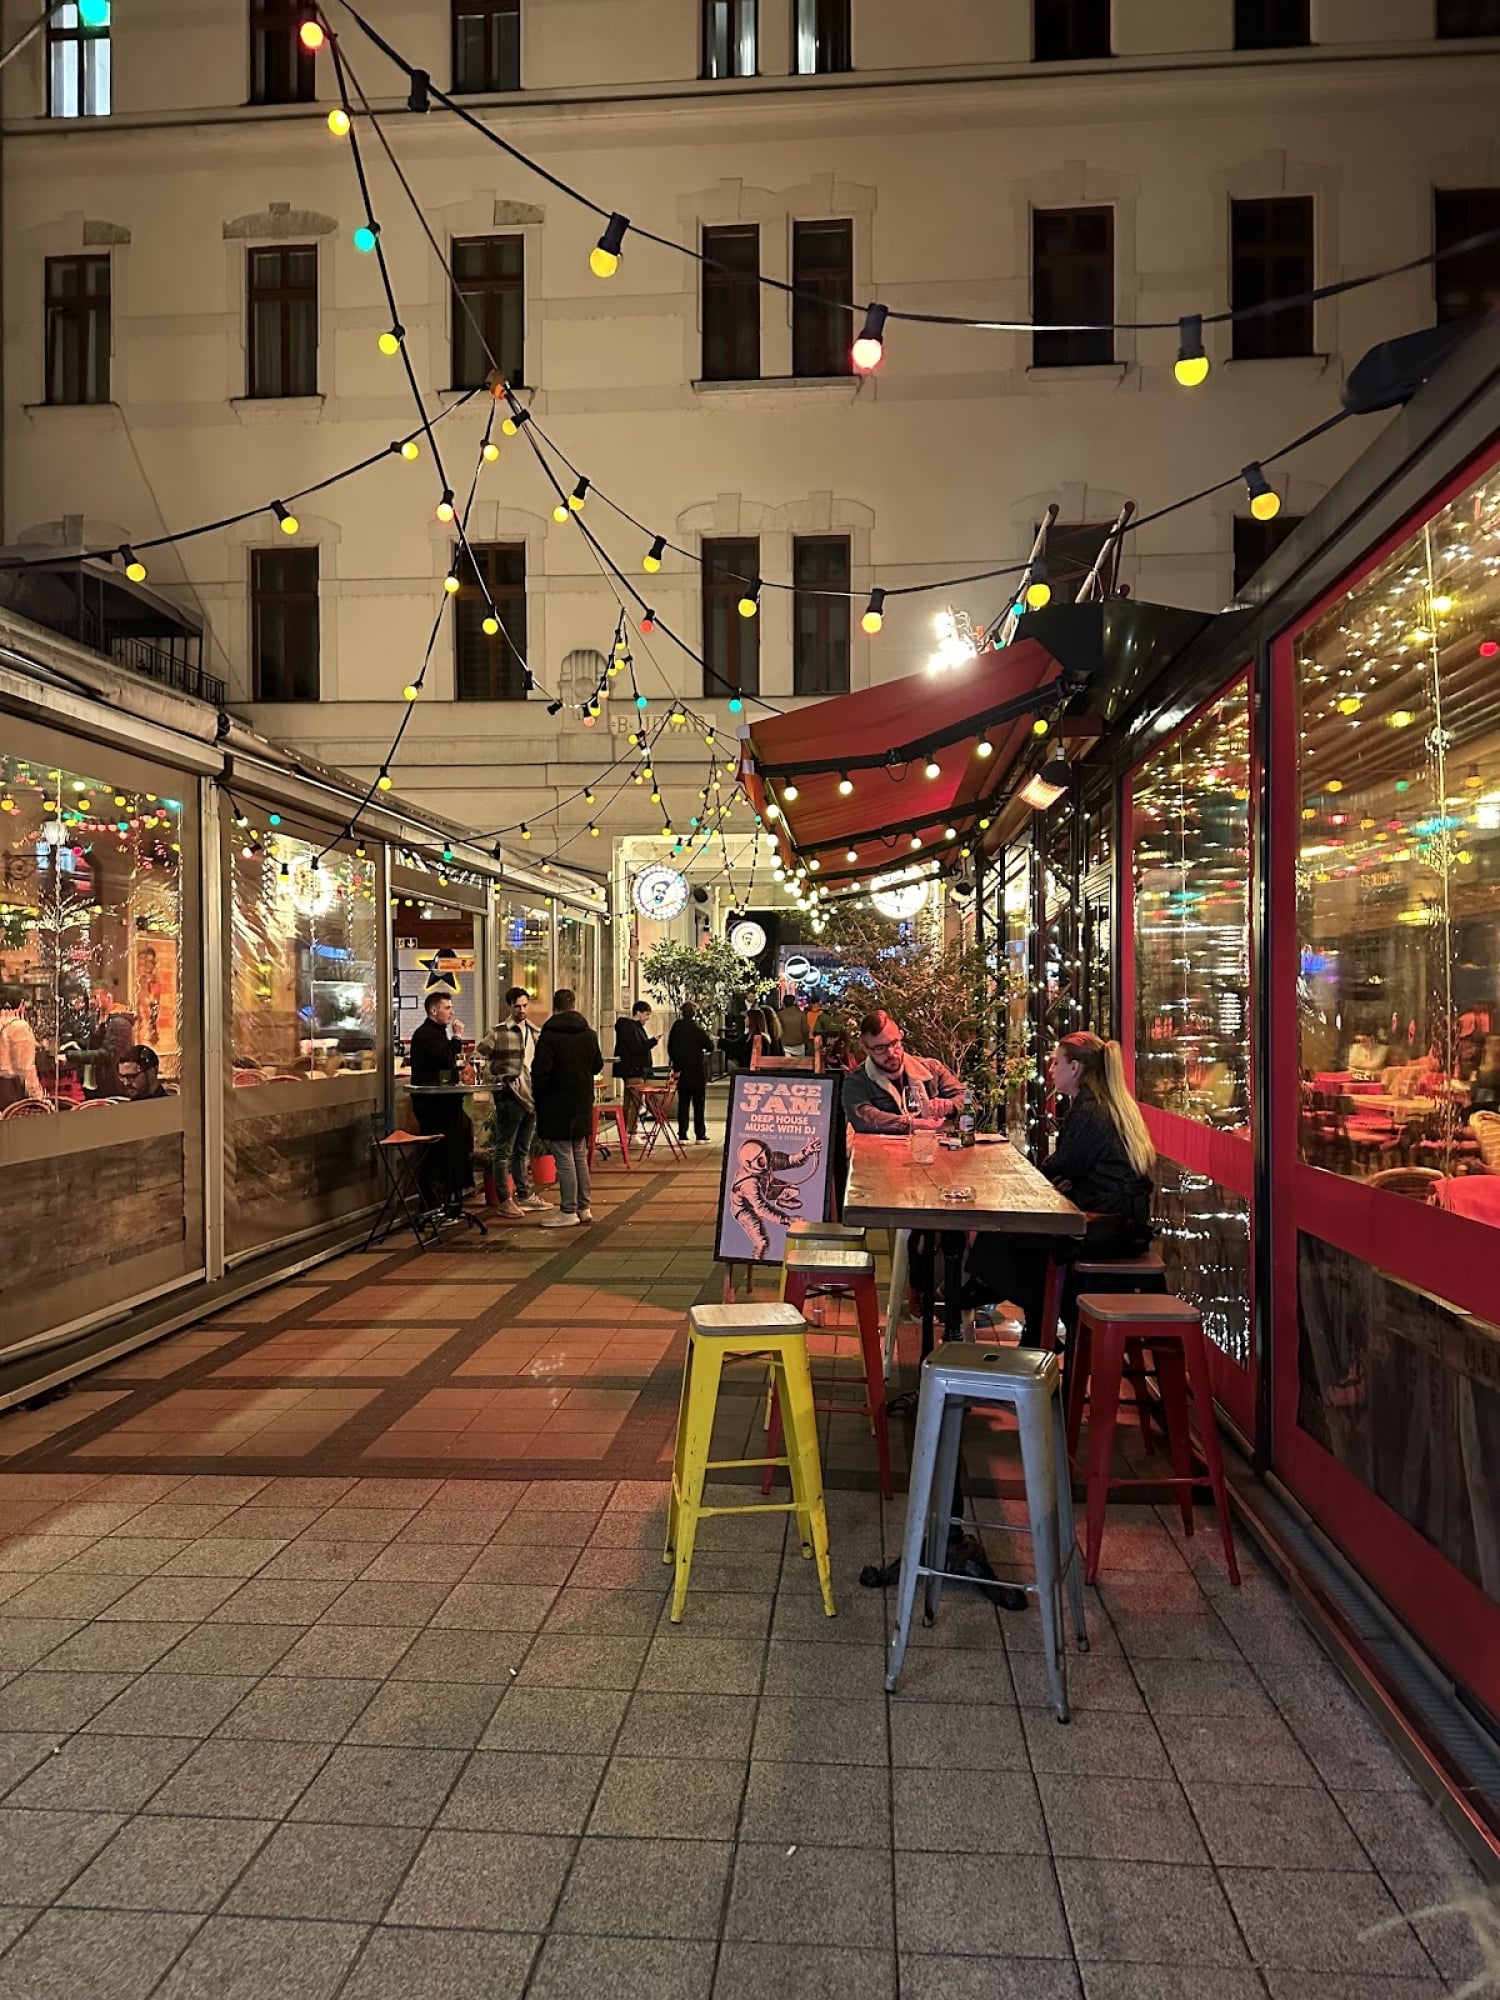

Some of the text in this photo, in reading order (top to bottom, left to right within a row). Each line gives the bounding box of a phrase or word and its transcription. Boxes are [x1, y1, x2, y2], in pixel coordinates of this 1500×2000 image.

[743, 1082, 821, 1097] SPACE
[739, 1094, 822, 1116] JAM
[751, 1114, 809, 1126] DEEP HOUSE
[744, 1123, 816, 1135] MUSIC WITH DJ
